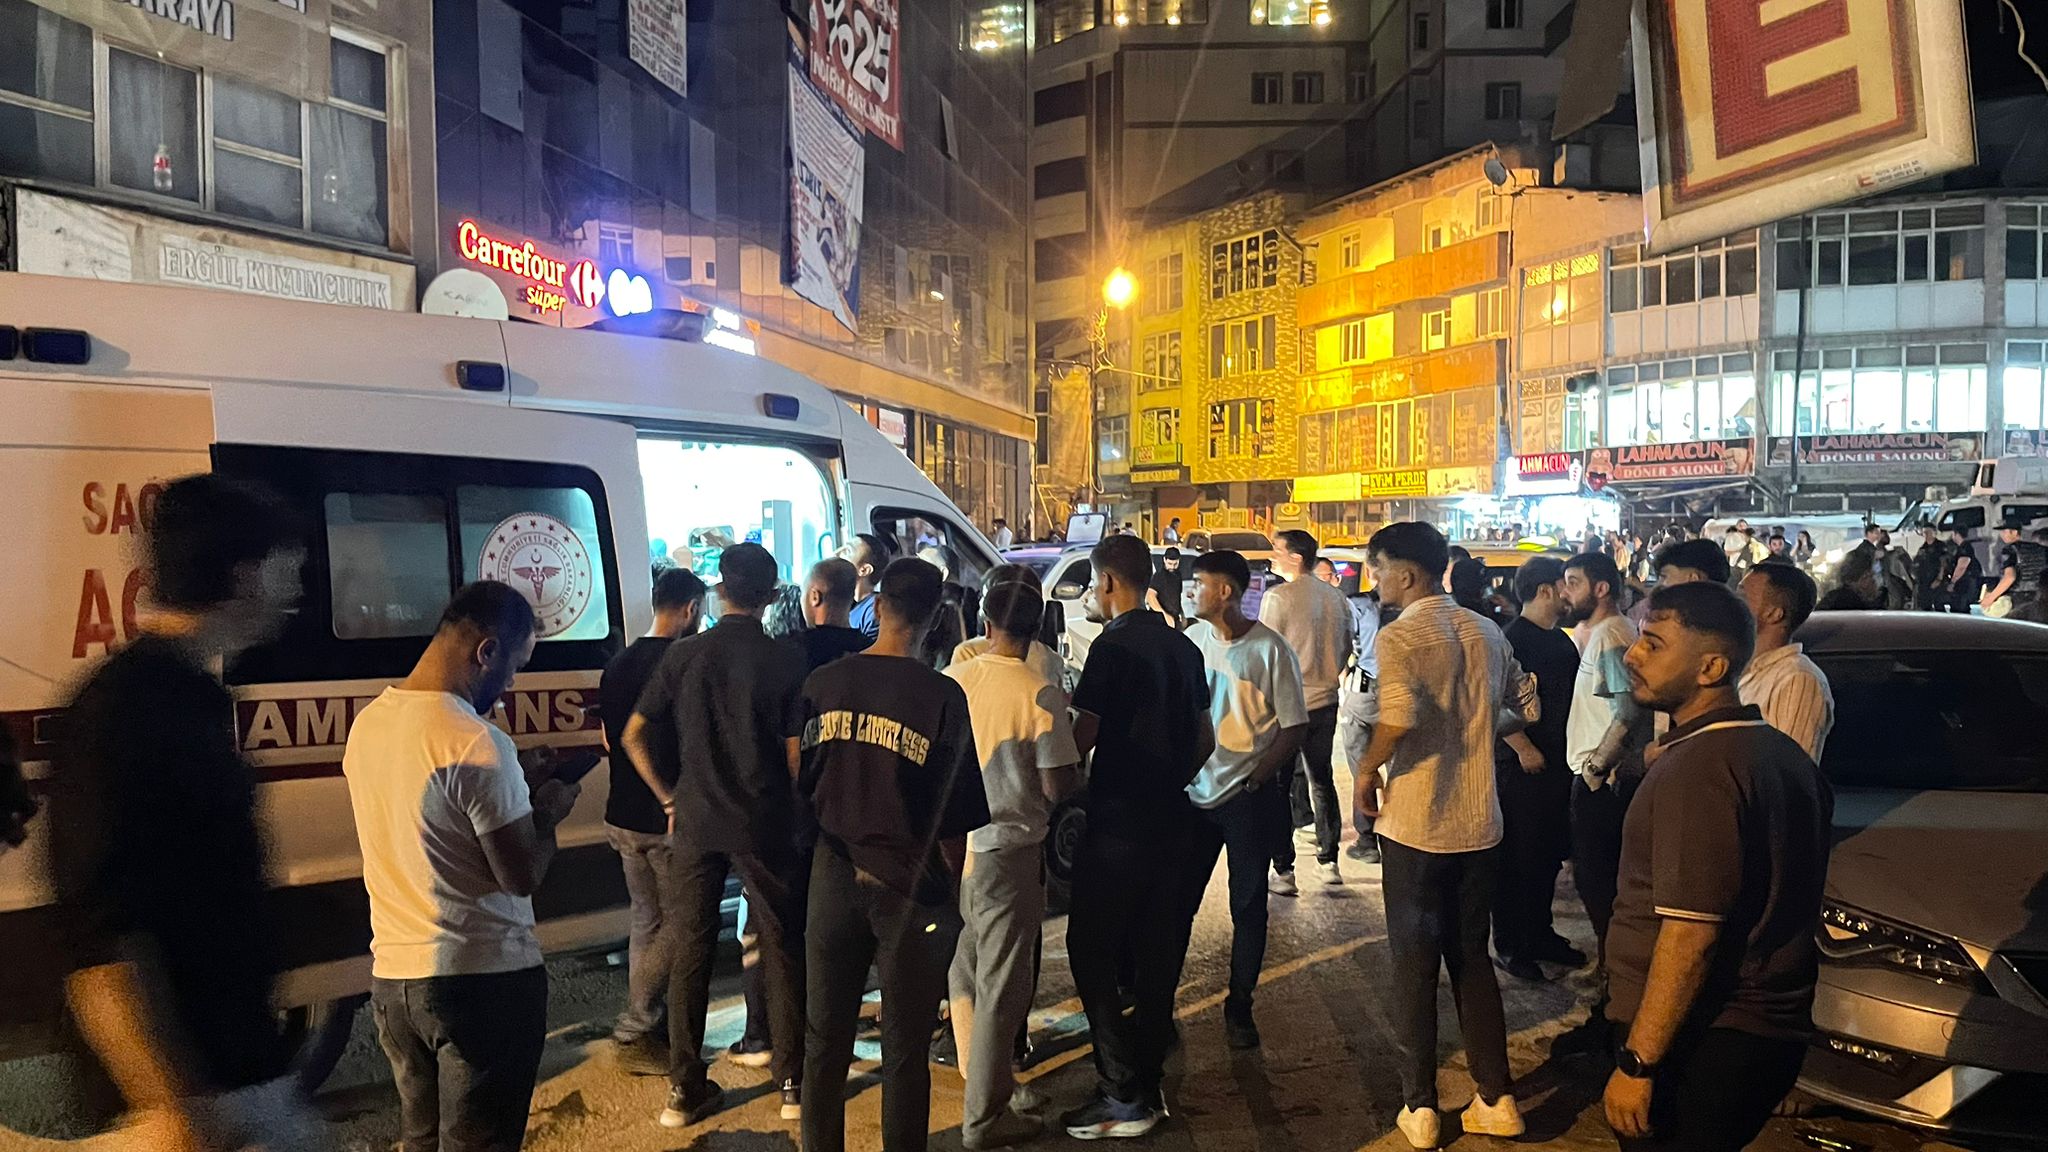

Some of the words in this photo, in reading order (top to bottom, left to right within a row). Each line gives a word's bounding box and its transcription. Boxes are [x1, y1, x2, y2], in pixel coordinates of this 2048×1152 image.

[459, 221, 567, 288] Carrefour
[164, 244, 242, 289] ERGÜL
[247, 260, 388, 309] KUYUMCULUK
[527, 285, 566, 315] süper
[1617, 441, 1726, 464] LAHMACUN
[1811, 432, 1949, 450] LAHMACUN
[1881, 451, 1947, 462] SALONU
[1395, 471, 1426, 487] PERDE
[1671, 462, 1724, 477] SALONU
[855, 712, 930, 767] LIMITLESS
